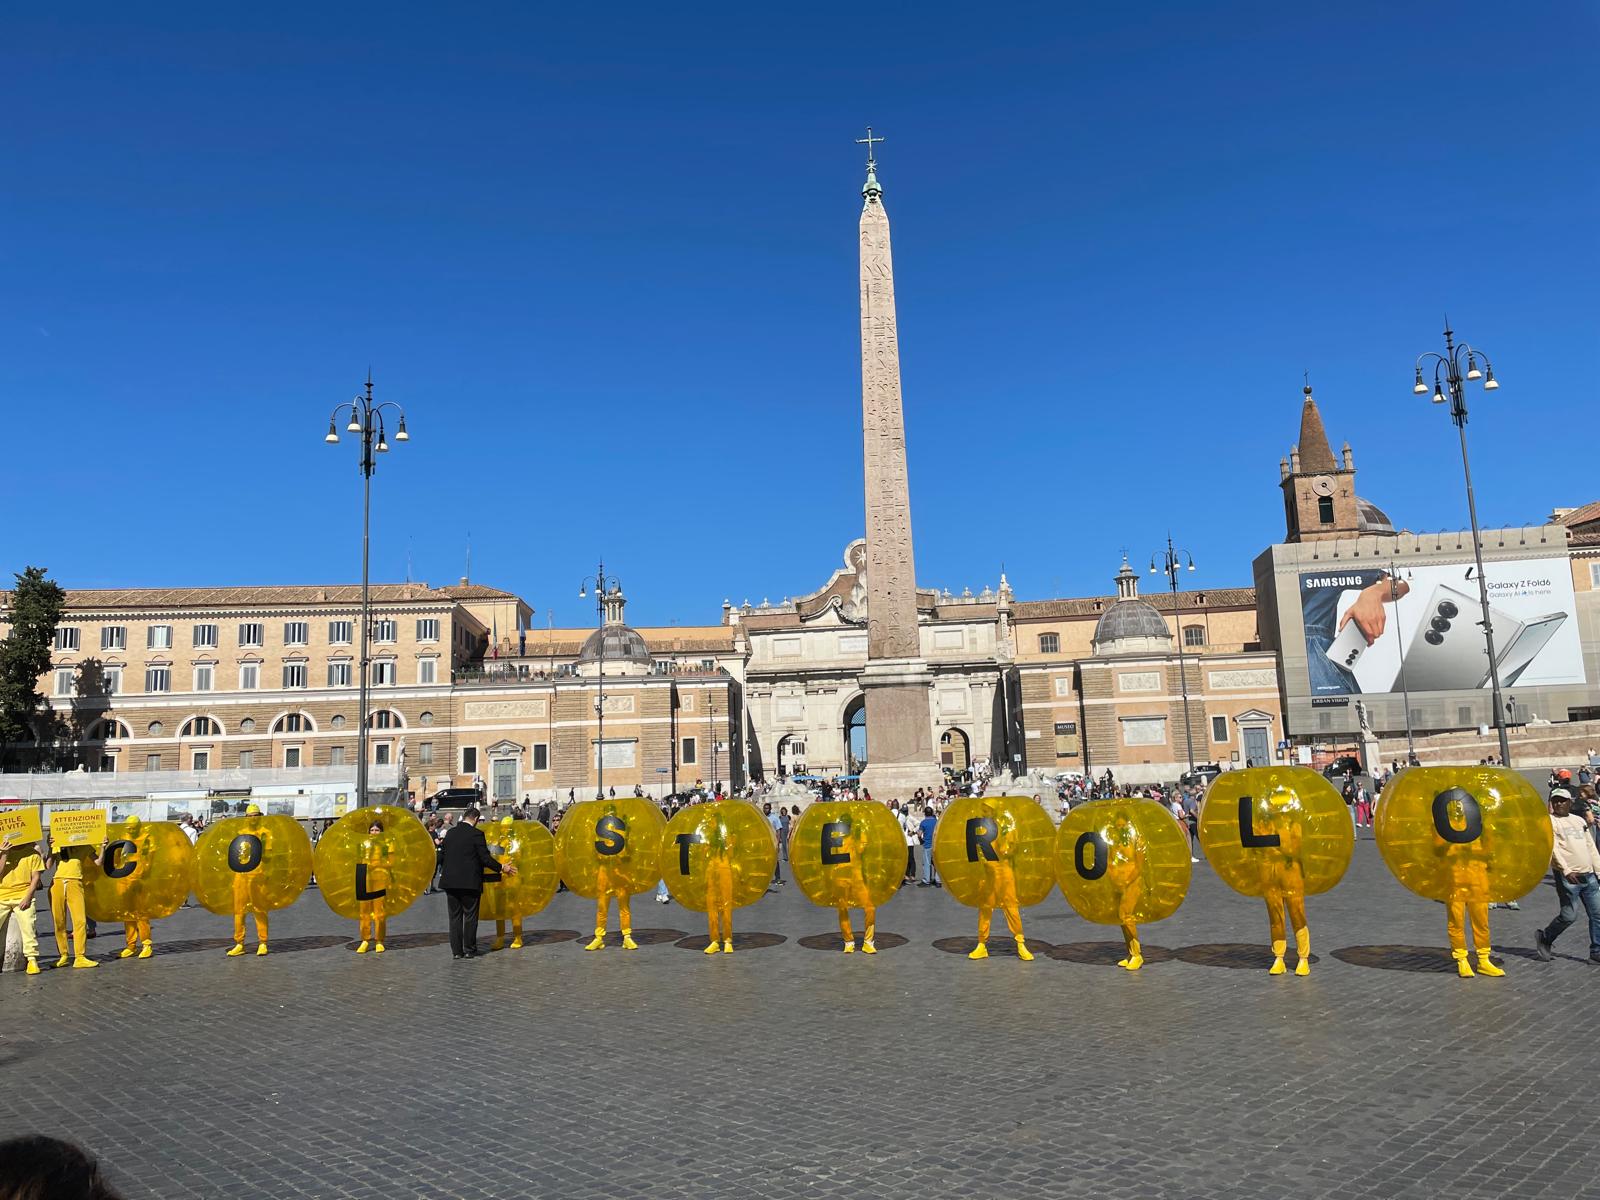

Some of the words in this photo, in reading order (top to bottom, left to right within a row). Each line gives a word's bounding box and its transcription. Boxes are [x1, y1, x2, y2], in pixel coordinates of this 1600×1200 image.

[1306, 576, 1362, 588] SAMSUNG
[1487, 582, 1519, 590] Galaxy
[1527, 579, 1551, 587] Fold6
[54, 814, 103, 823] ATTENZIONE!
[7, 822, 26, 830] VITA
[103, 840, 137, 879] C
[227, 834, 262, 873] O
[356, 864, 386, 901] L
[595, 816, 626, 856] S
[675, 834, 702, 876] T
[820, 821, 851, 865] E
[965, 817, 999, 863] R
[1074, 831, 1109, 881] O
[1239, 796, 1281, 849] L
[1432, 788, 1482, 844] O
